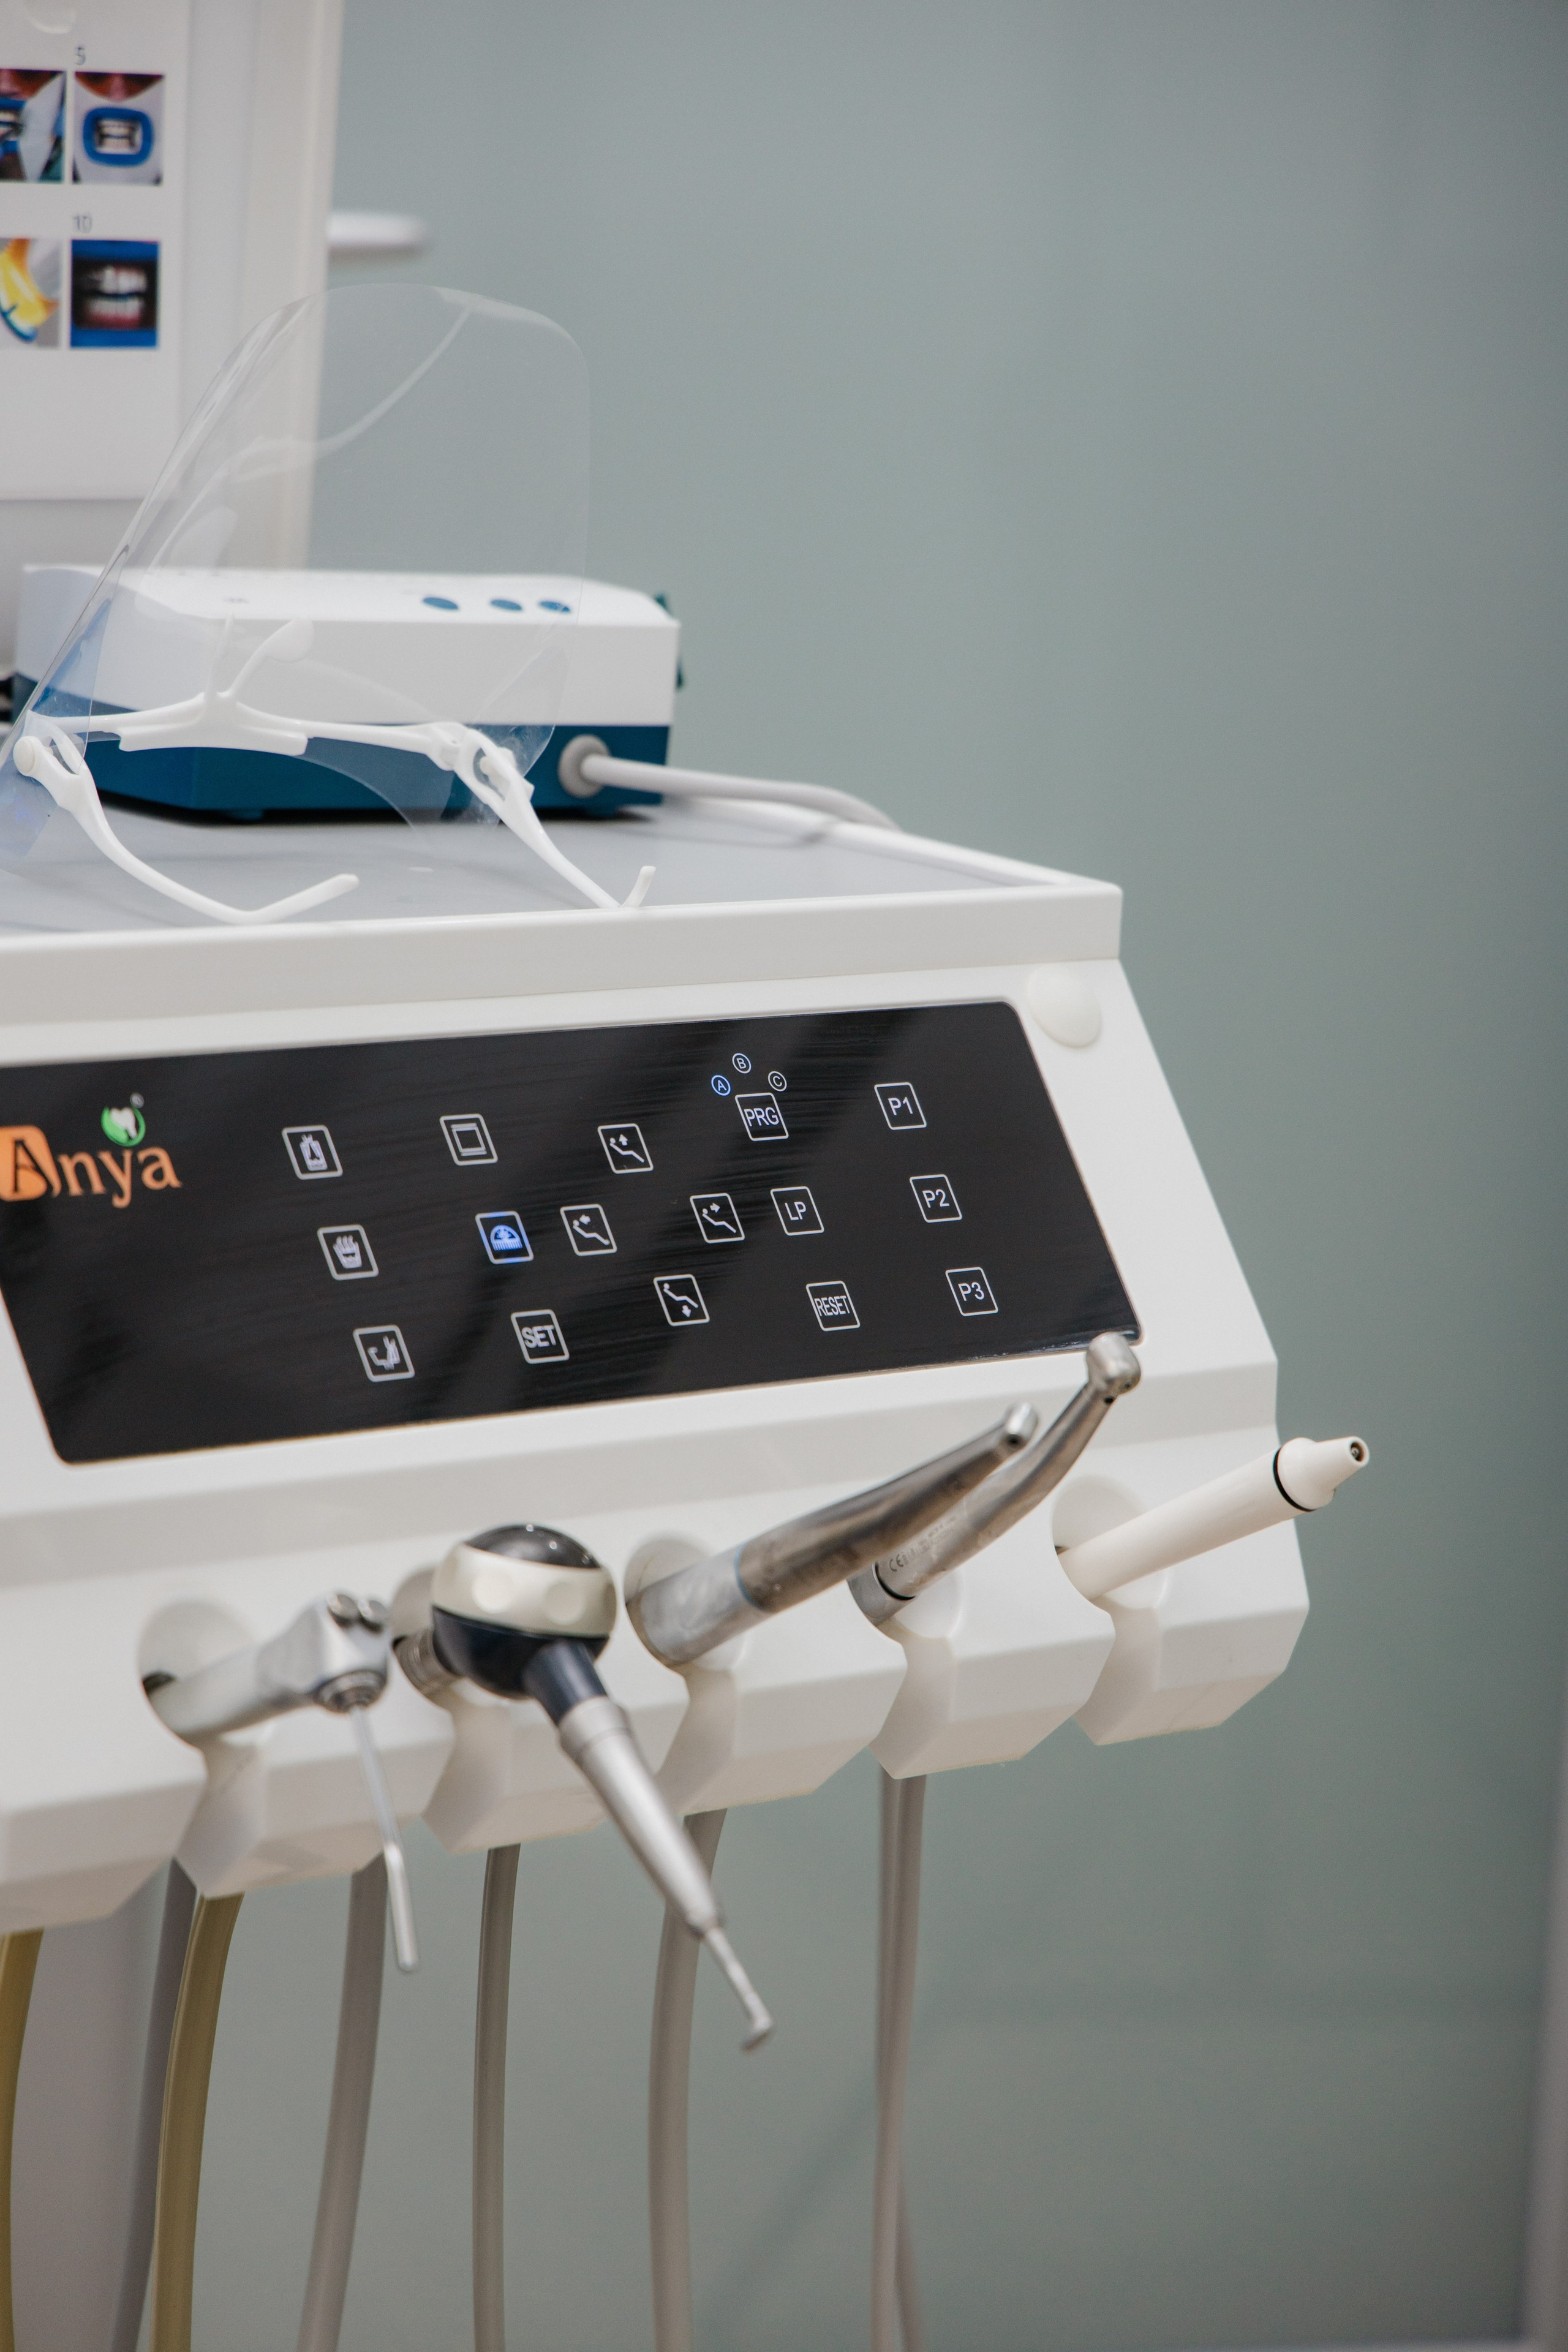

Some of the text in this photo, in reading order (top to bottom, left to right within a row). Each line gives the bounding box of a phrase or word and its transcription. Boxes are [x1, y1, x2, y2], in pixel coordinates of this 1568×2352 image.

[76, 47, 86, 66] 5
[74, 214, 92, 233] 10
[888, 1096, 913, 1116] P1
[744, 1107, 780, 1127] PRG
[10, 1136, 183, 1208] Anya
[922, 1189, 950, 1208] P2
[785, 1201, 807, 1221] LP
[957, 1281, 985, 1302] P3
[813, 1295, 850, 1317] RESET
[521, 1324, 557, 1348] SET
